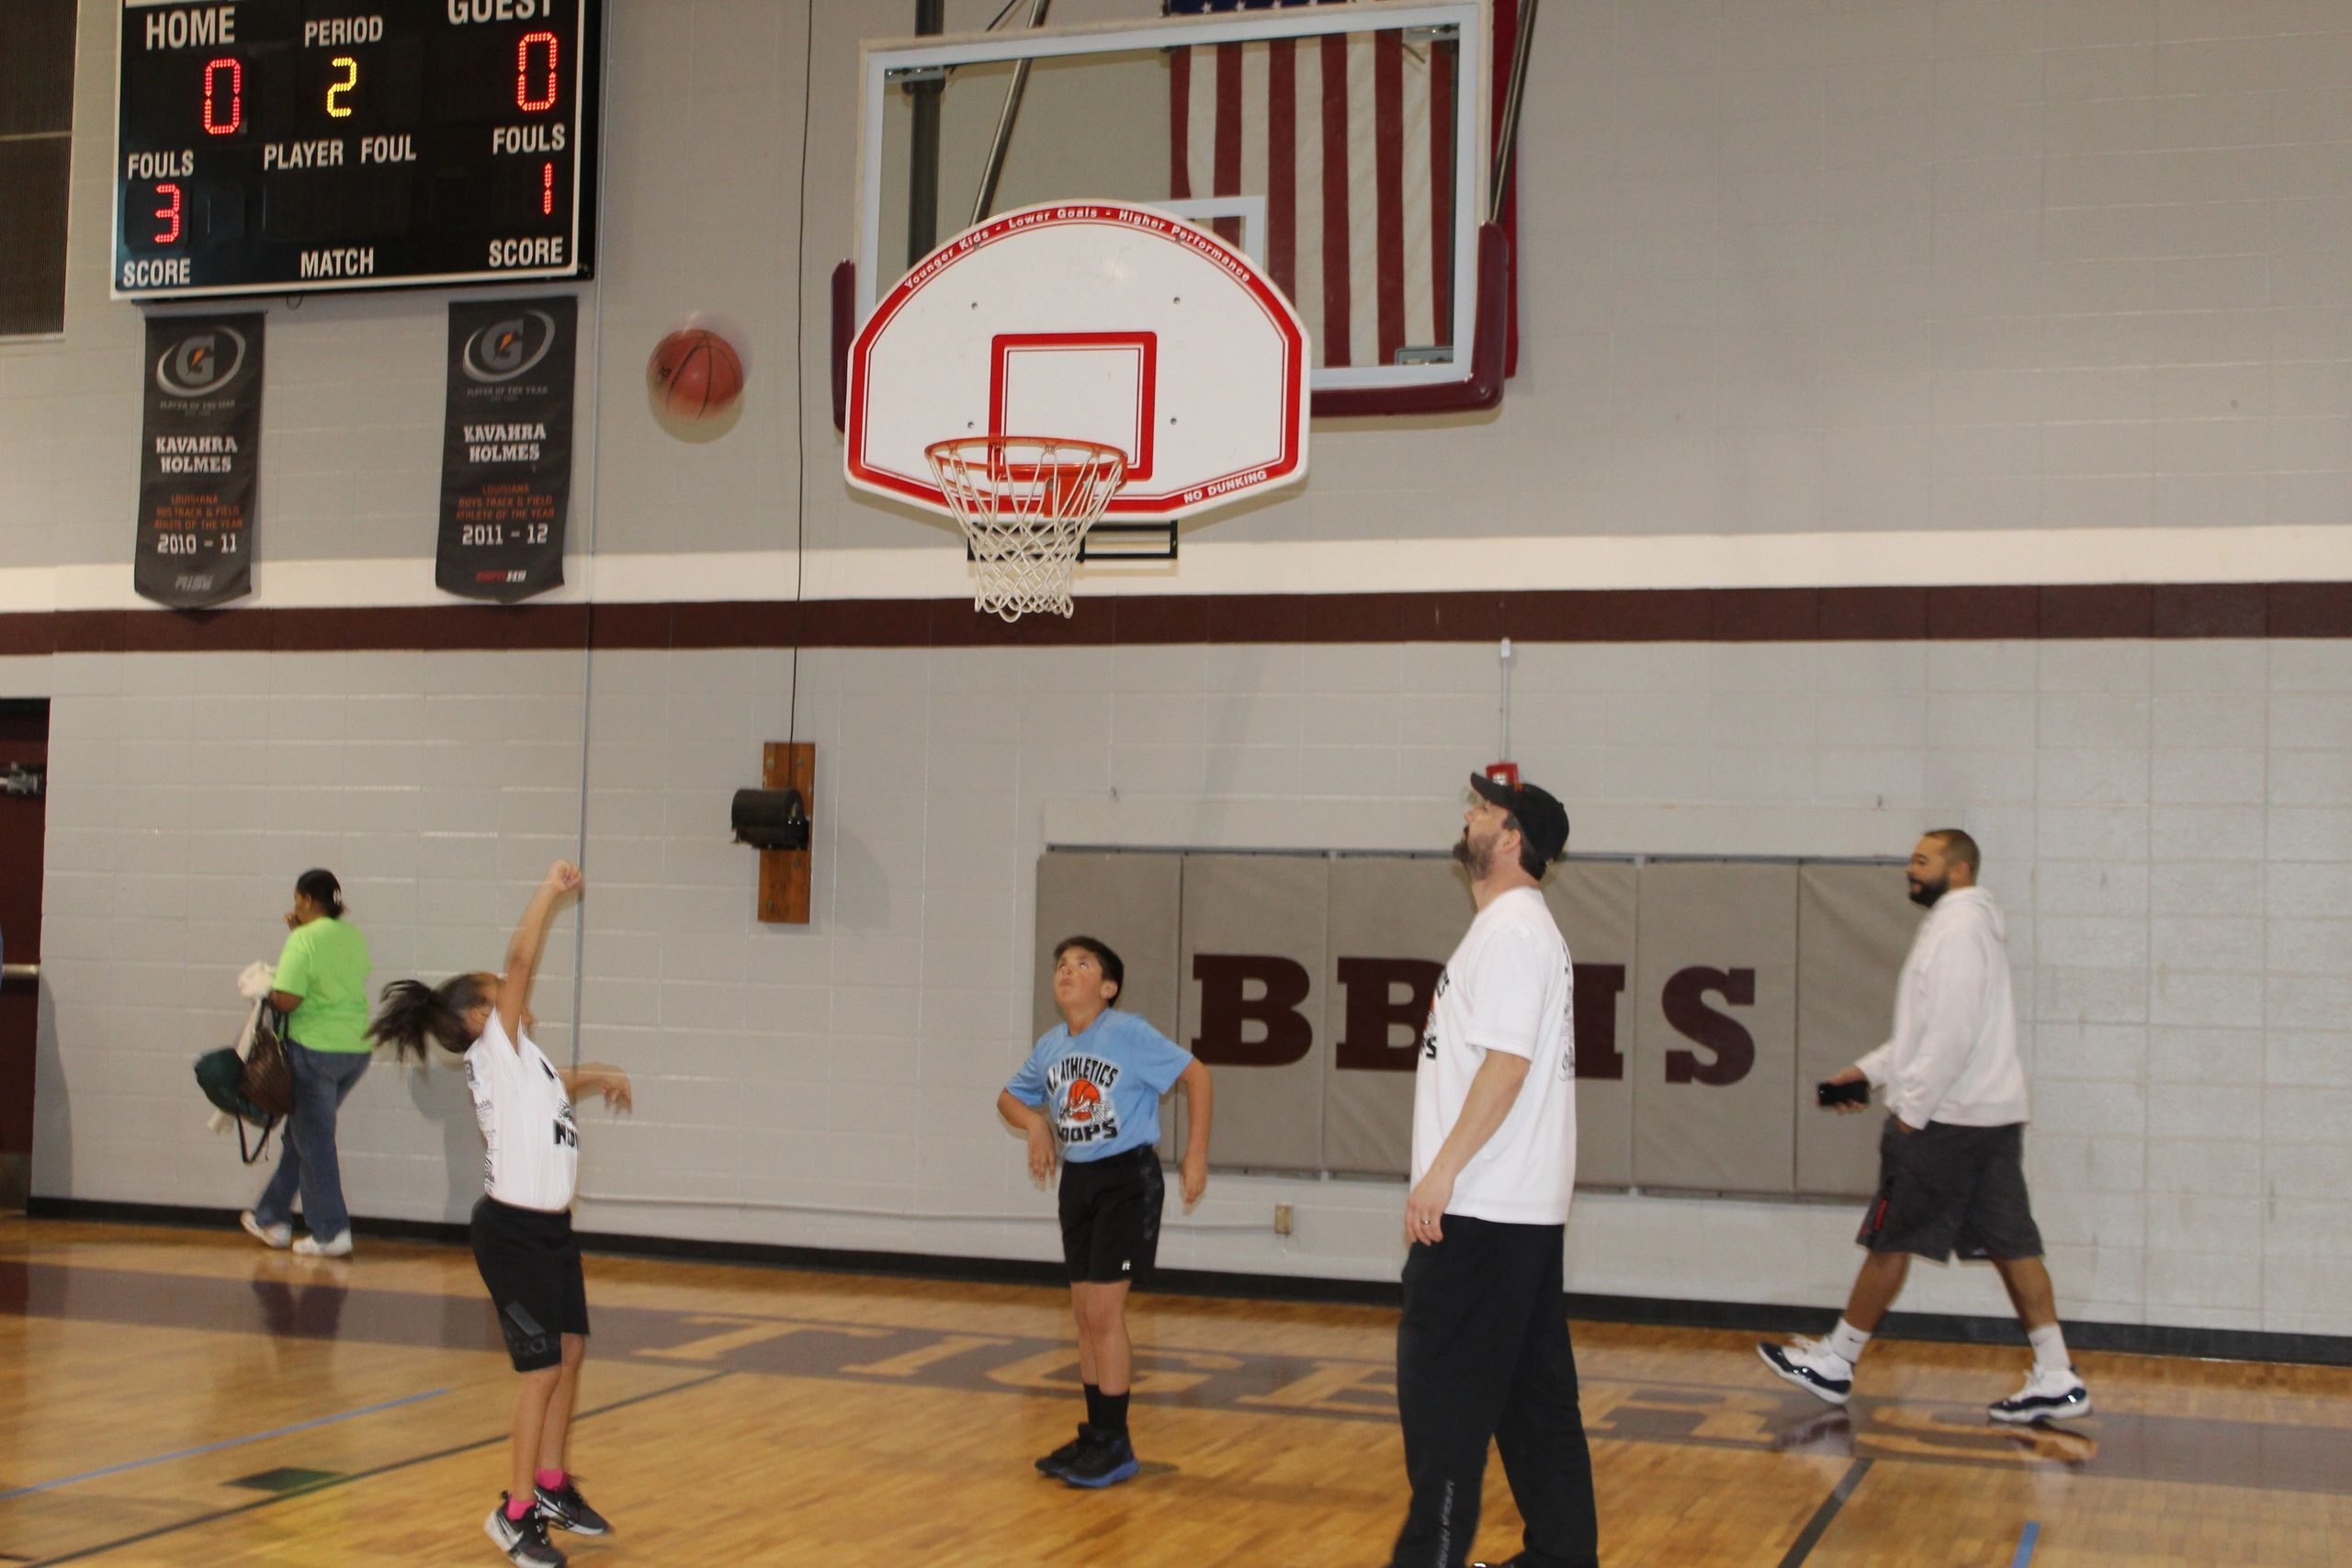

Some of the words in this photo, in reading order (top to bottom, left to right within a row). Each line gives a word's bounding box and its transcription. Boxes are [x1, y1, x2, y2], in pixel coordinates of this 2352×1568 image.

[145, 7, 236, 50] HOME
[304, 16, 384, 47] PERIOD
[326, 56, 357, 118] 2
[516, 31, 558, 112] 0
[203, 57, 241, 135] 0
[263, 140, 345, 172] PLAYER
[360, 134, 417, 164] FOUL
[492, 123, 566, 154] FOULS
[128, 150, 194, 180] FOULS
[543, 162, 552, 216] 1
[154, 183, 181, 243] 3
[300, 247, 375, 278] MATCH
[489, 236, 563, 267] SCORE
[904, 249, 955, 290] Younger
[958, 231, 990, 252] Kids
[1008, 212, 1050, 230] Lower
[1057, 207, 1098, 220] Goals
[1118, 209, 1166, 231] Higher
[1170, 224, 1250, 283] Performance
[123, 258, 191, 288] SCORE
[160, 455, 232, 473] HOLMES
[469, 443, 540, 463] HOLMES
[1183, 491, 1203, 503] NO
[1207, 469, 1267, 496] DUNKING
[157, 534, 197, 554] 2010
[220, 533, 236, 553] 11
[462, 524, 503, 546] 2011
[526, 523, 548, 544] 12
[1061, 1057, 1119, 1089] ATHLETICS
[1057, 1118, 1118, 1144] OOPS
